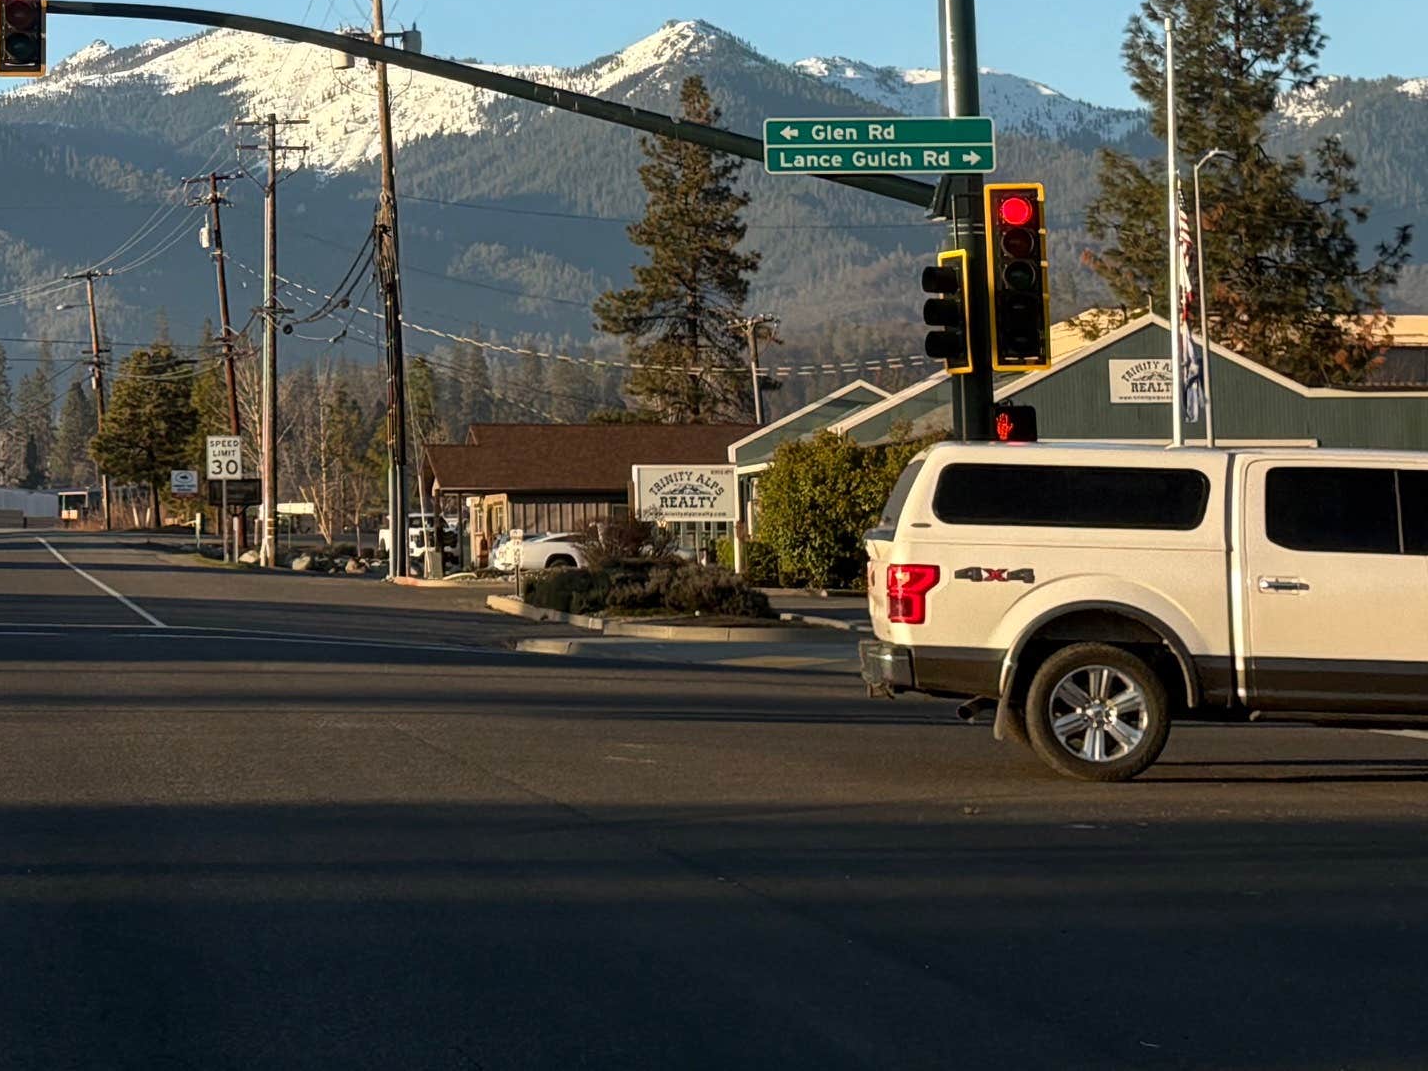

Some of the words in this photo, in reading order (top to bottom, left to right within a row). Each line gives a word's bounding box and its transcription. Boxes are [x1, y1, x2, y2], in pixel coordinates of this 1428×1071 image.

[811, 124, 858, 141] Glen
[868, 124, 896, 141] Rd
[779, 151, 843, 168] Lance
[852, 150, 913, 168] Gulch
[923, 150, 950, 167] Rd
[1121, 361, 1160, 383] TRINITY
[1131, 382, 1173, 393] REALT
[212, 449, 237, 457] LIMIT
[212, 459, 239, 475] 30
[648, 471, 693, 496] TRINITY
[695, 473, 725, 496] ALPS
[659, 496, 718, 508] REALTY
